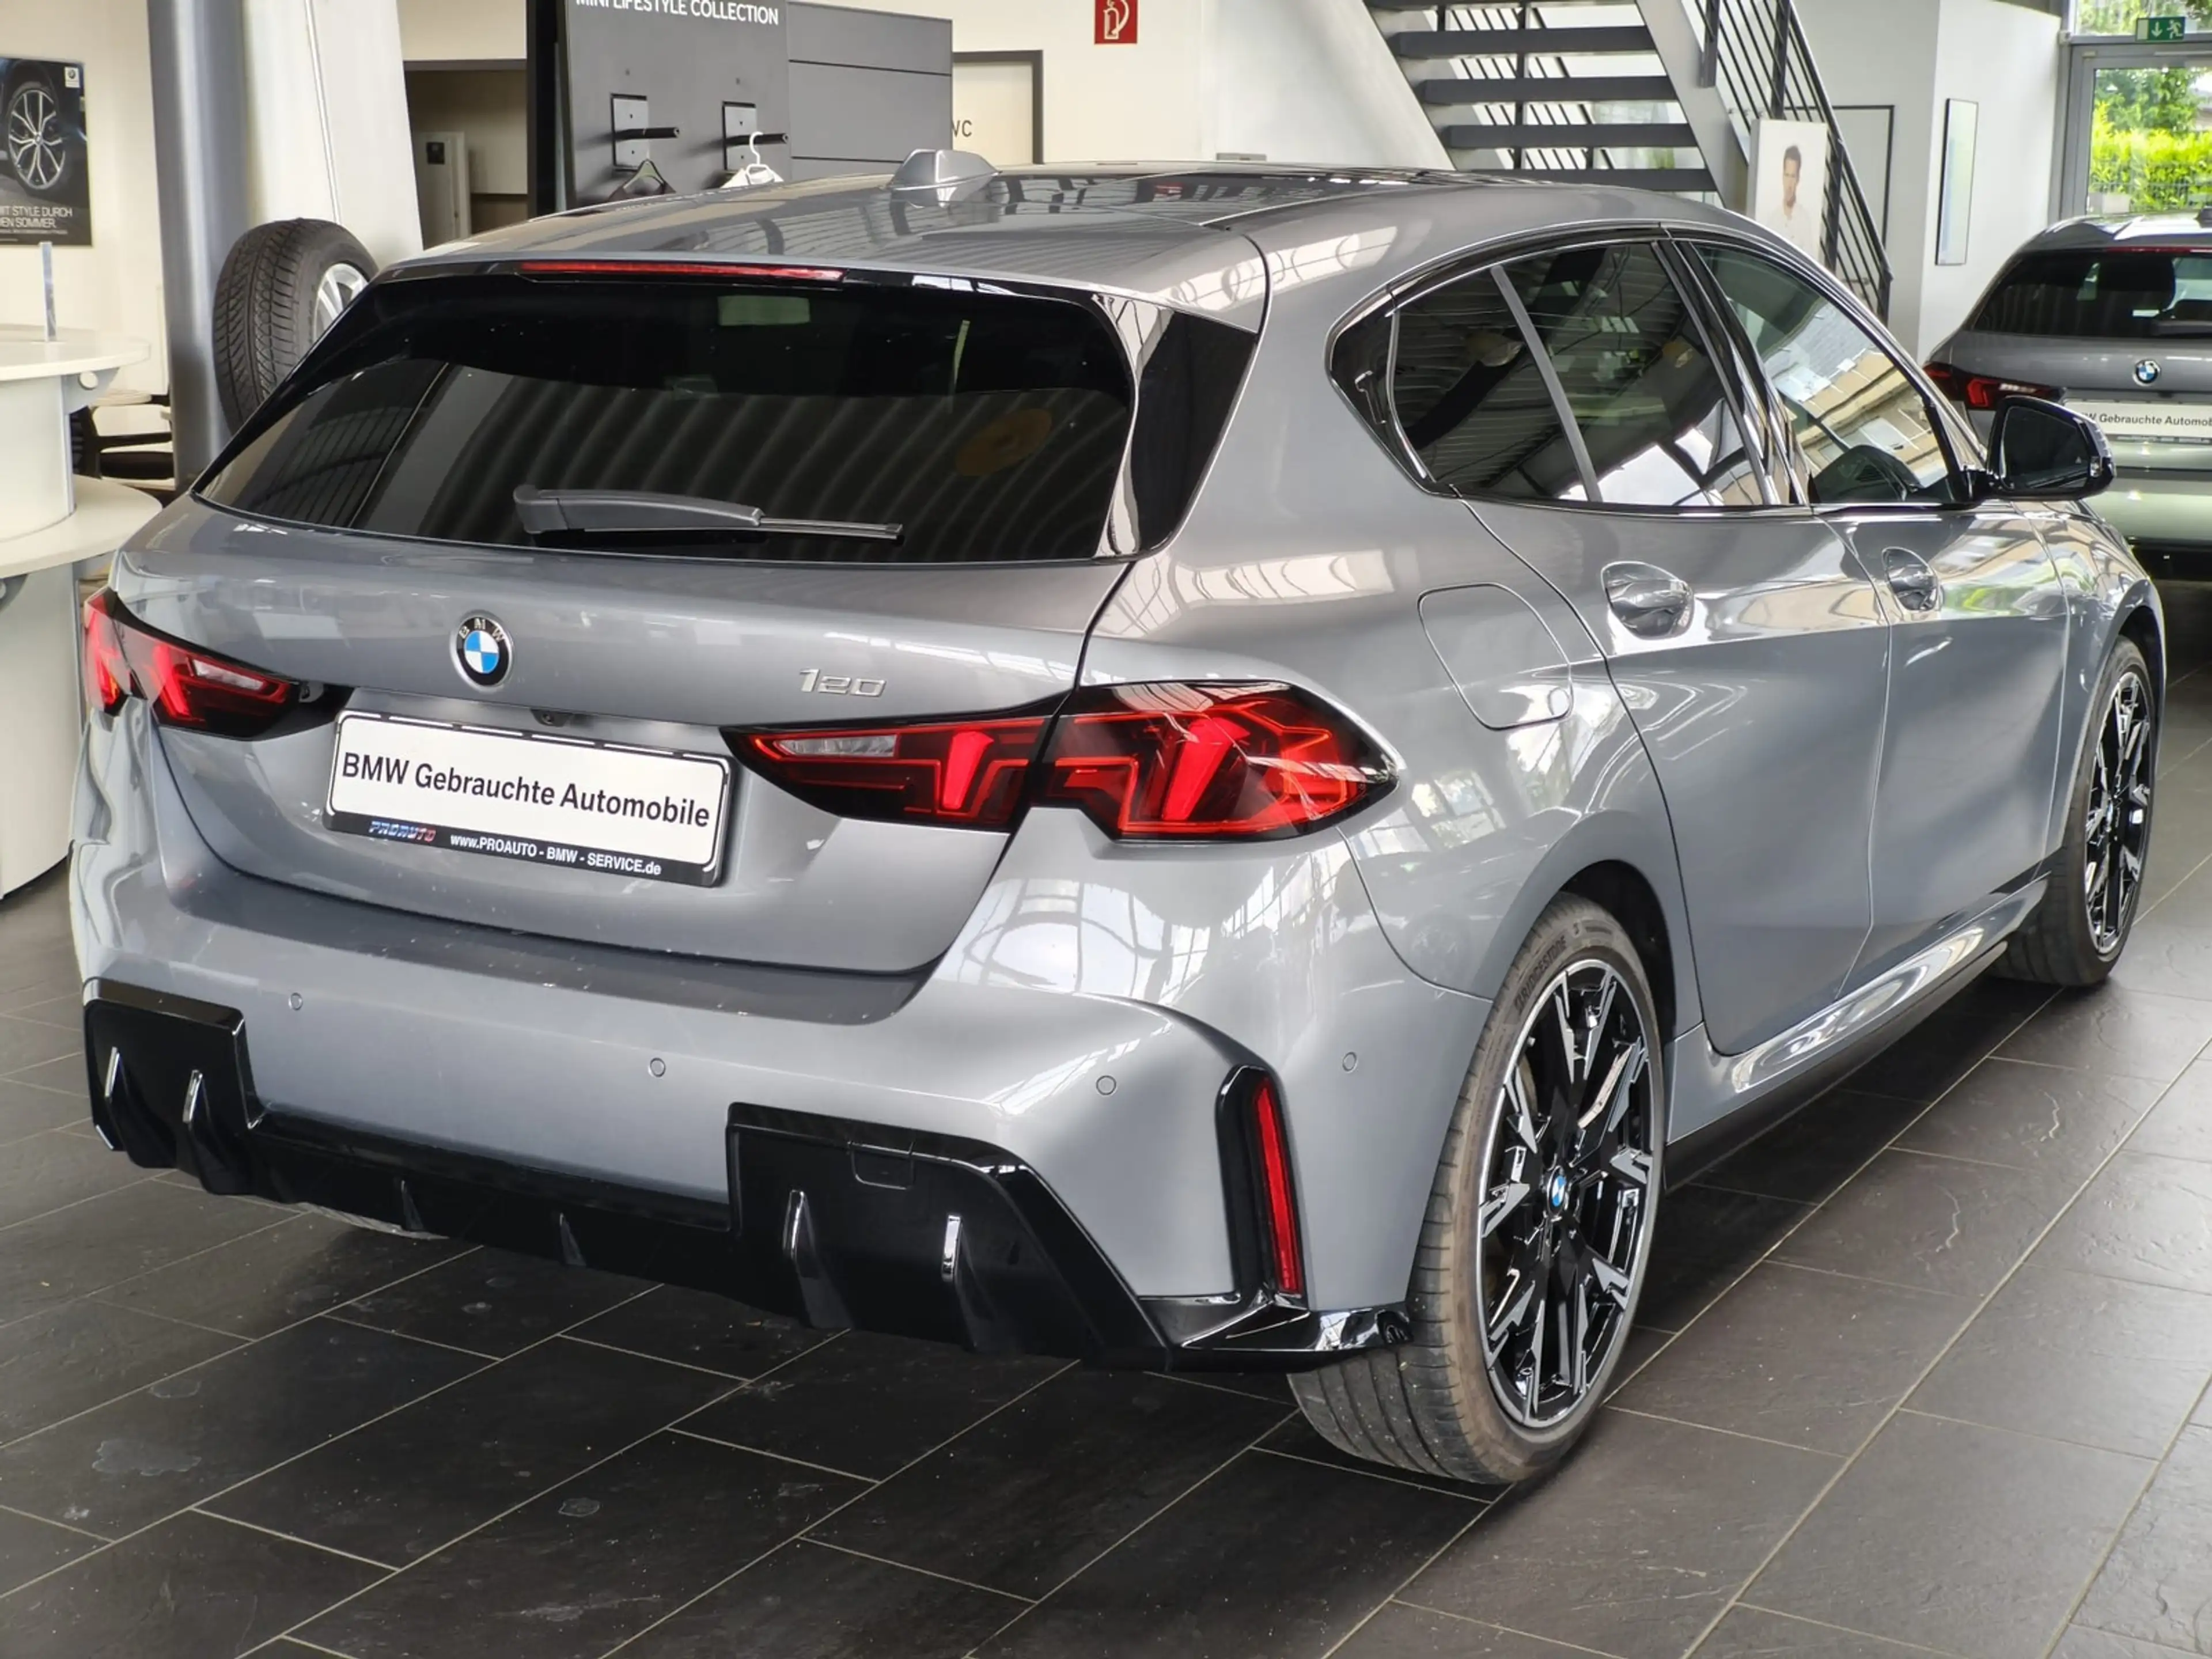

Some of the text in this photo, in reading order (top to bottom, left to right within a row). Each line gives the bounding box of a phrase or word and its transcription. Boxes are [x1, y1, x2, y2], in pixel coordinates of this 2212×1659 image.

[691, 0, 778, 25] COLLECTION
[12, 206, 40, 217] STYLE
[2099, 413, 2162, 425] Gebrauchte
[459, 618, 505, 642] BMW
[800, 668, 887, 698] 120
[342, 752, 710, 827] BMW Gebrauchte Automobile
[368, 820, 437, 843] PROAUTO
